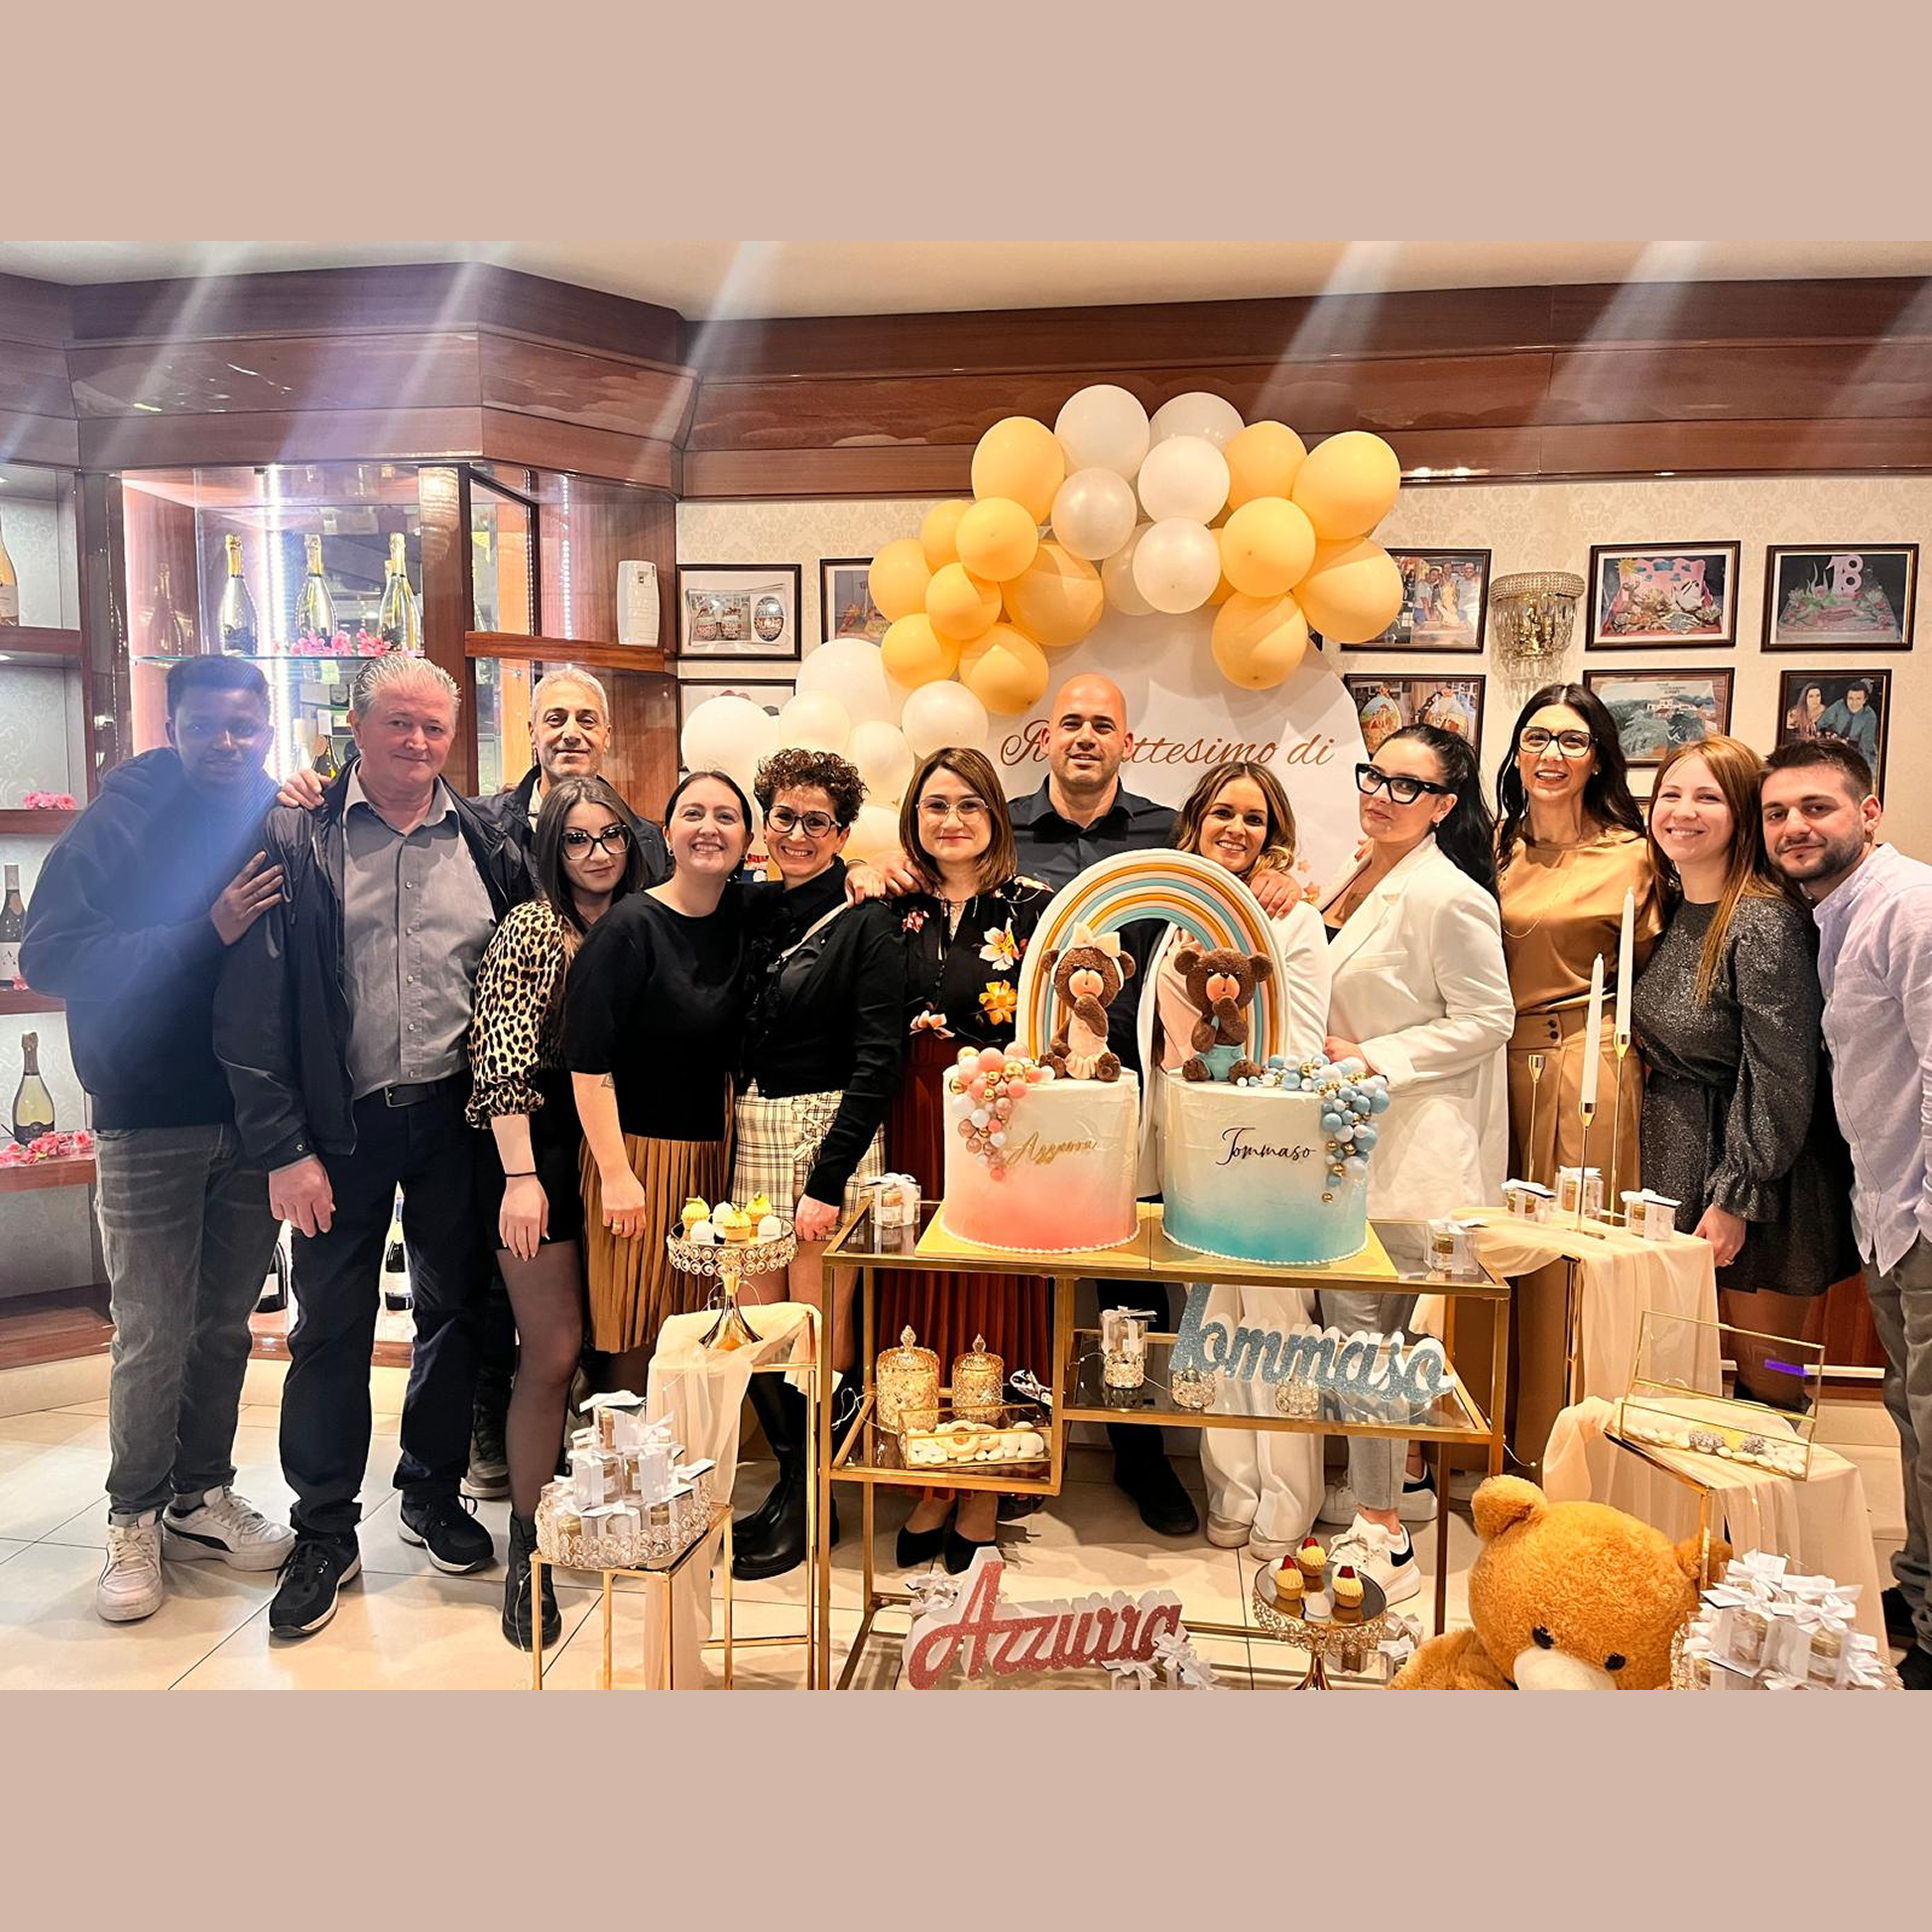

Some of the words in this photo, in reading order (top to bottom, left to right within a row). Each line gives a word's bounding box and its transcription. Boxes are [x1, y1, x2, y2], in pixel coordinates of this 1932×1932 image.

[1122, 737, 1277, 765] ttesimo
[1286, 733, 1335, 765] di
[1215, 1127, 1316, 1166] Tommaso
[907, 1557, 1190, 1690] Azzurra
